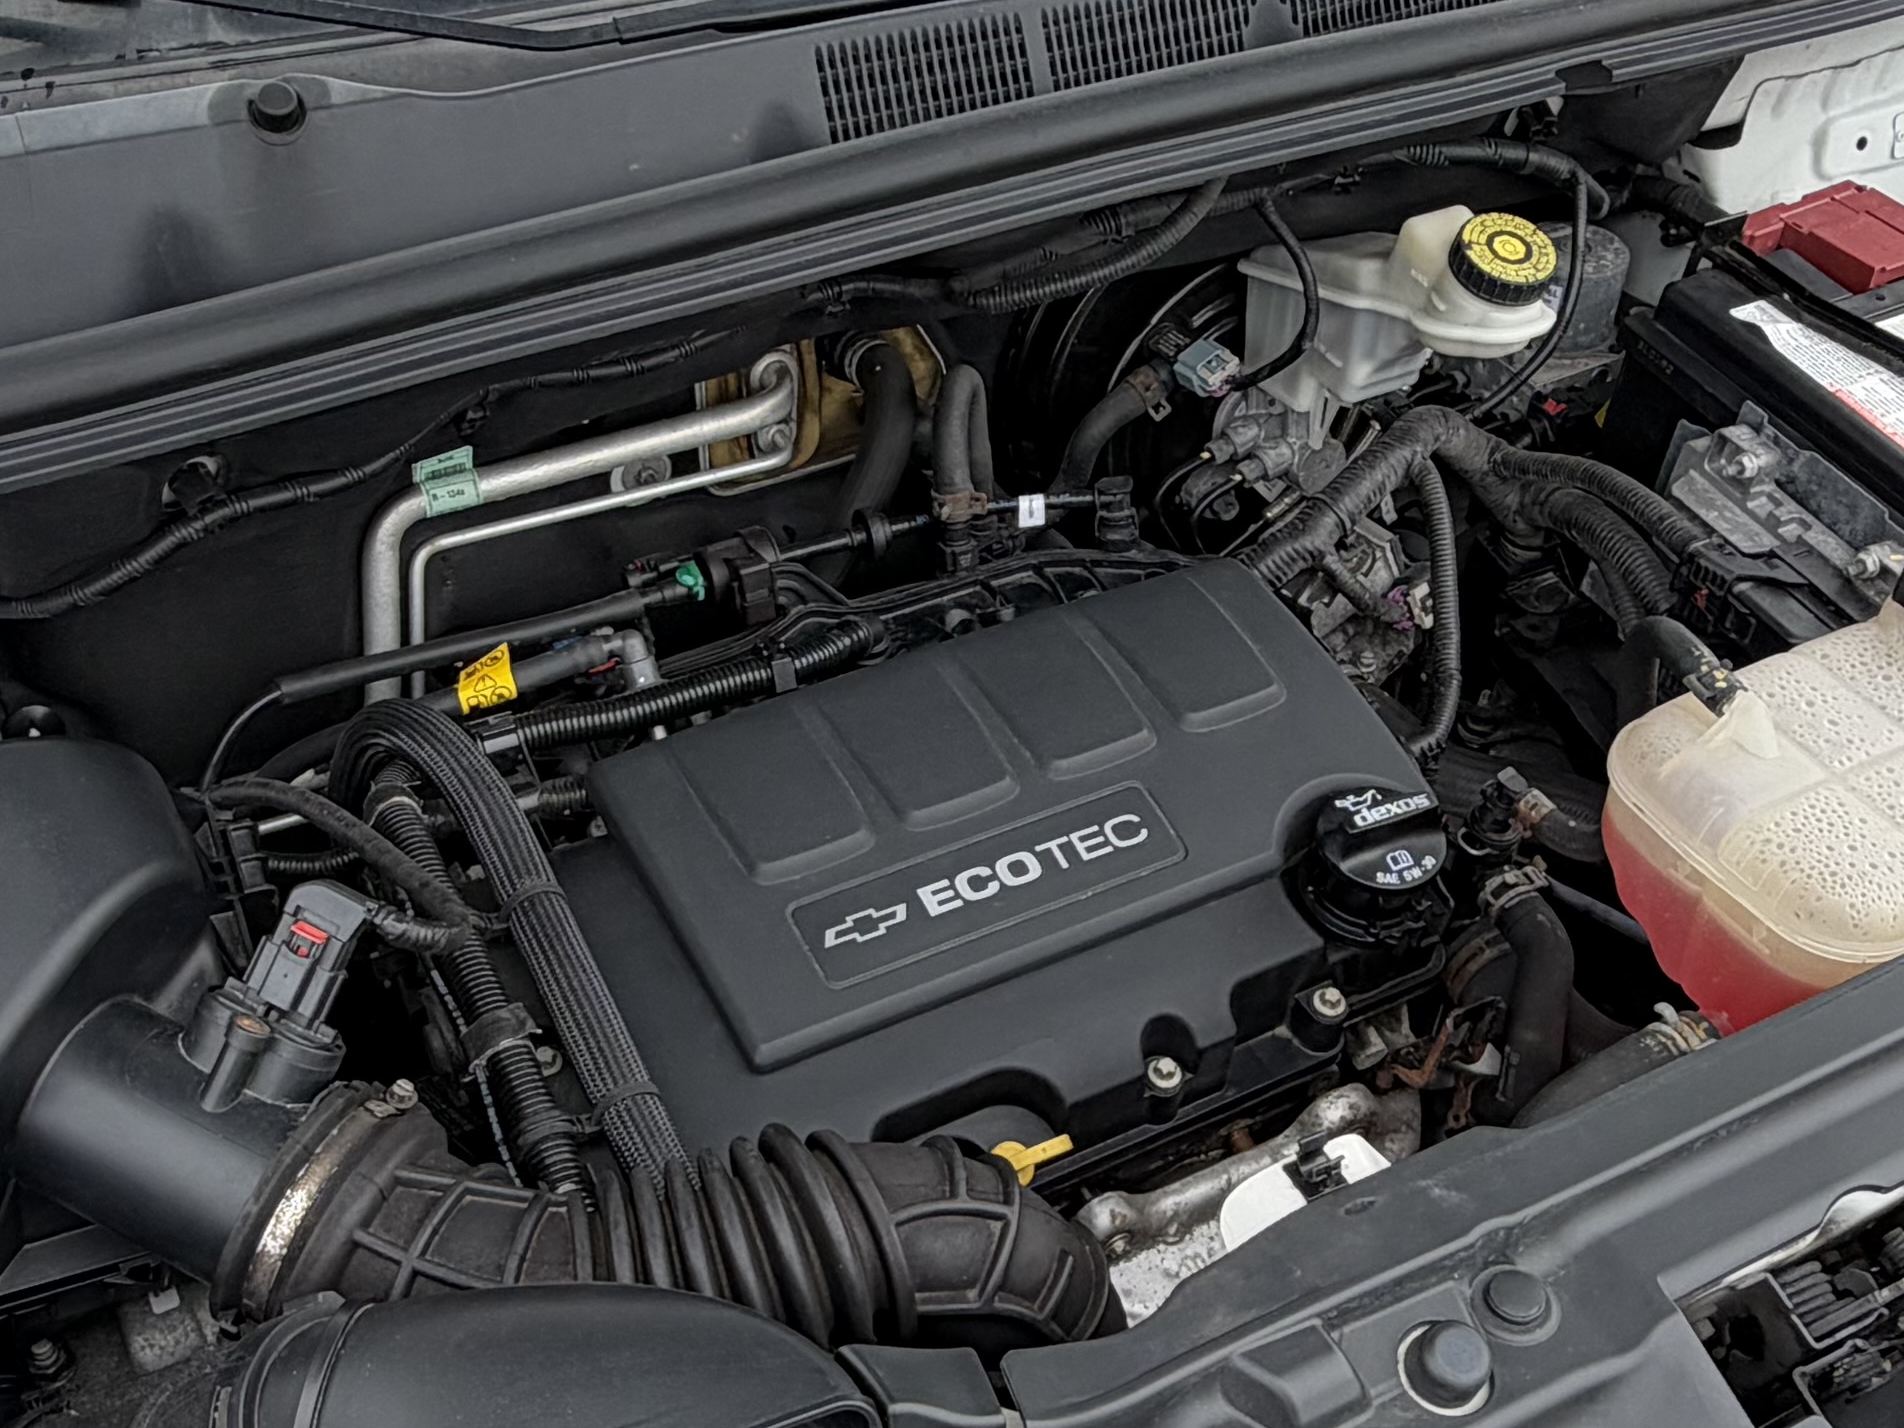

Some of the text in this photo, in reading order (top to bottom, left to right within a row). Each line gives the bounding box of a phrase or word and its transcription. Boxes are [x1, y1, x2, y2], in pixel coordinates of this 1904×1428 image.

[1353, 793, 1431, 827] dexos
[916, 811, 1150, 917] ECOTEC
[1376, 871, 1401, 884] SAE
